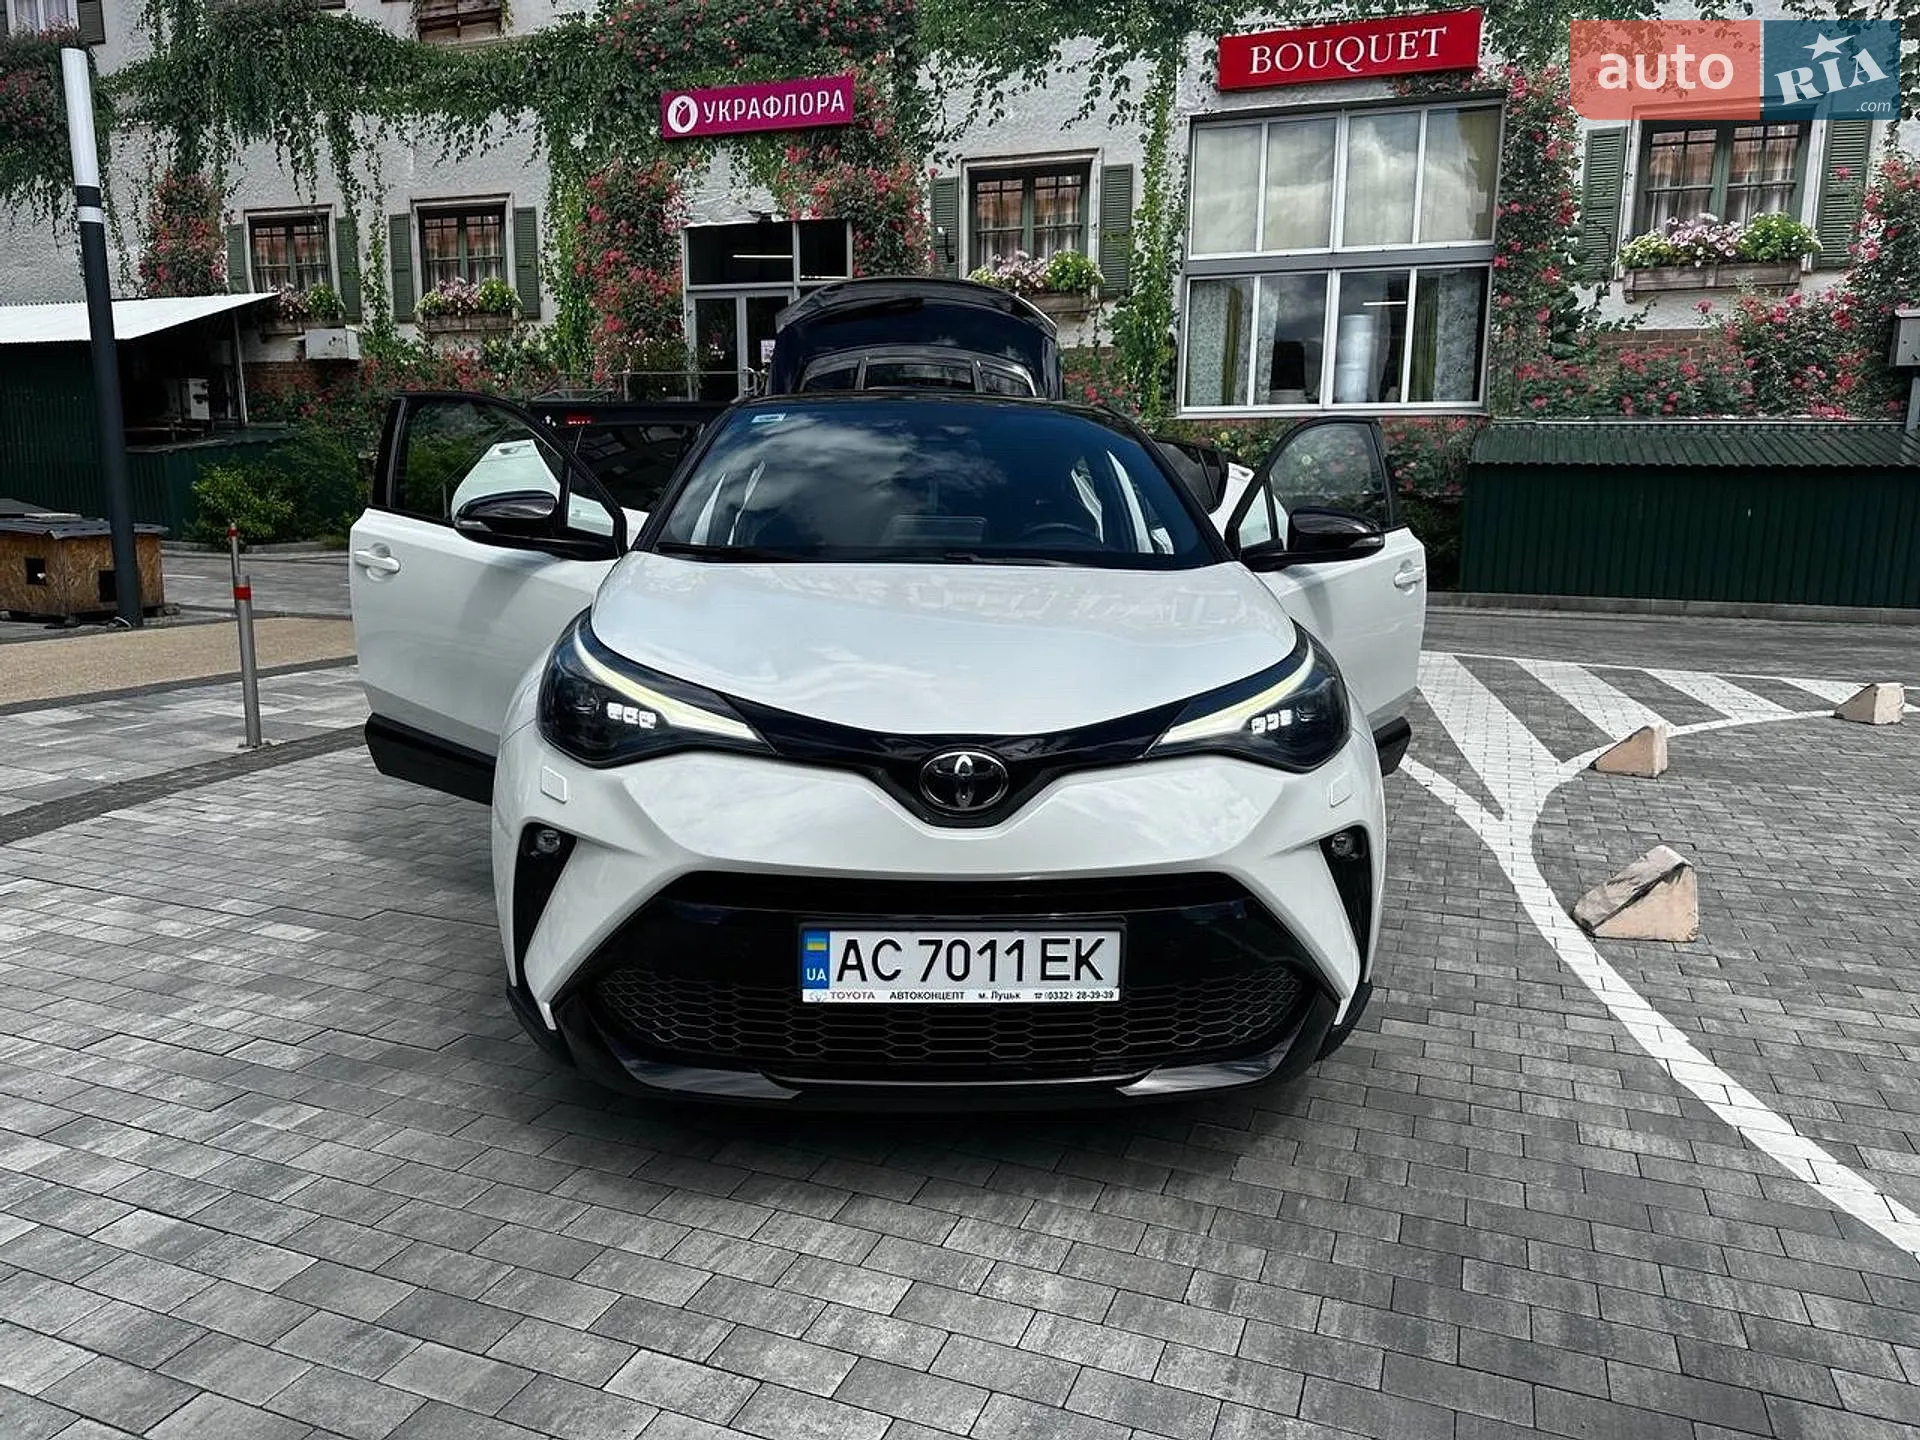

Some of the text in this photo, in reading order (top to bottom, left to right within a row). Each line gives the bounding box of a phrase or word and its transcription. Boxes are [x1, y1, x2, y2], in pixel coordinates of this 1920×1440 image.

[1249, 26, 1447, 75] BOUQUET
[703, 89, 846, 123] УКРАФЛОРА
[836, 937, 1106, 983] AC 7011 EK
[806, 968, 827, 982] UA
[830, 991, 876, 1000] TOYOTA
[889, 991, 965, 1001] АВТОКОНЦЕПТ
[991, 990, 1021, 1001] Луцьк
[1076, 990, 1115, 1000] 28-39-39
